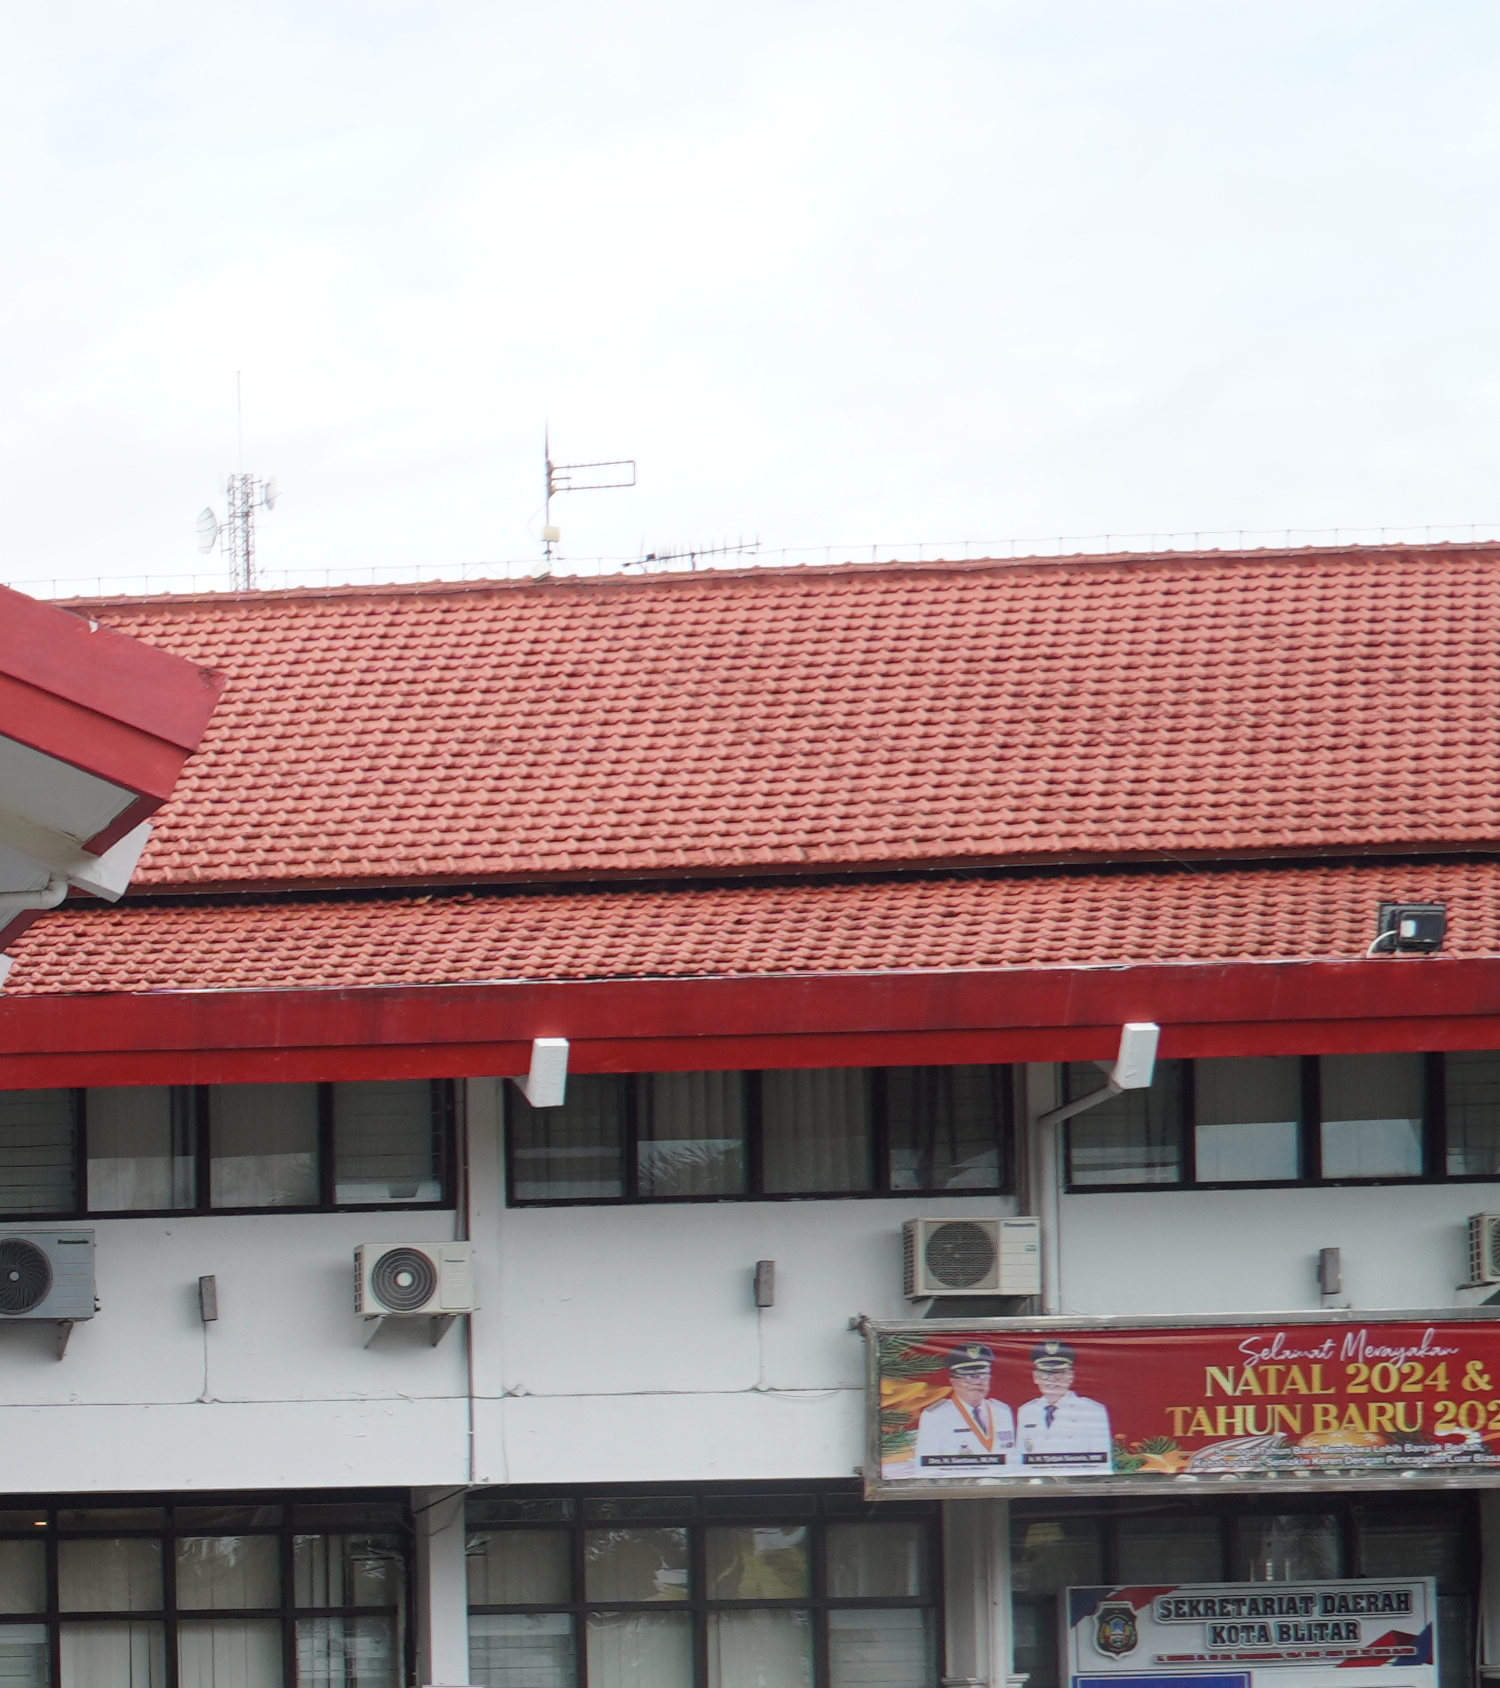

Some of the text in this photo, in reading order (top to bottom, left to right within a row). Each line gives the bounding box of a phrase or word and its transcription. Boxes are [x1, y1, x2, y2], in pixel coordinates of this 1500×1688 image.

[1238, 1327, 1461, 1369] Selamat Merayakan
[1204, 1360, 1493, 1397] NATAL 2024 &
[1164, 1399, 1500, 1437] TAHUN BARU 202
[1158, 1592, 1411, 1620] SEKRETARIAT DAERAH
[1210, 1620, 1360, 1645] KOTA BLITAR
